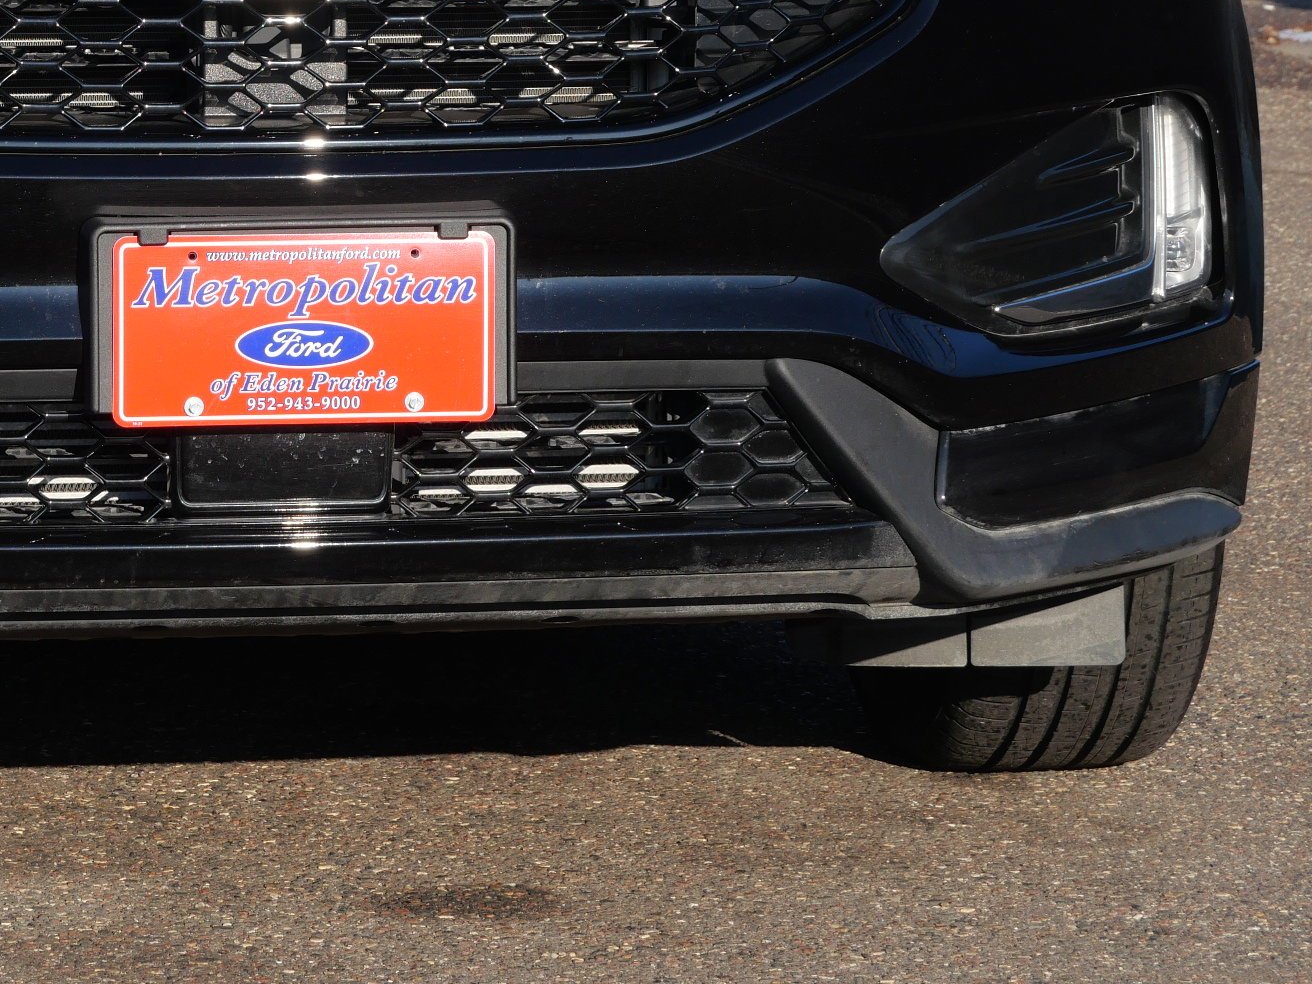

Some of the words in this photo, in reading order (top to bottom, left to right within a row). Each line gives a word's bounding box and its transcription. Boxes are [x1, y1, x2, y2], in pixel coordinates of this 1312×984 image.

[206, 246, 401, 264] www.metropolitanford.com
[131, 262, 477, 319] Metropolitan
[264, 328, 342, 358] Ford
[210, 371, 236, 400] of
[240, 373, 302, 393] Eden
[308, 369, 399, 393] Prairie
[246, 396, 361, 411] 952-943-9000
